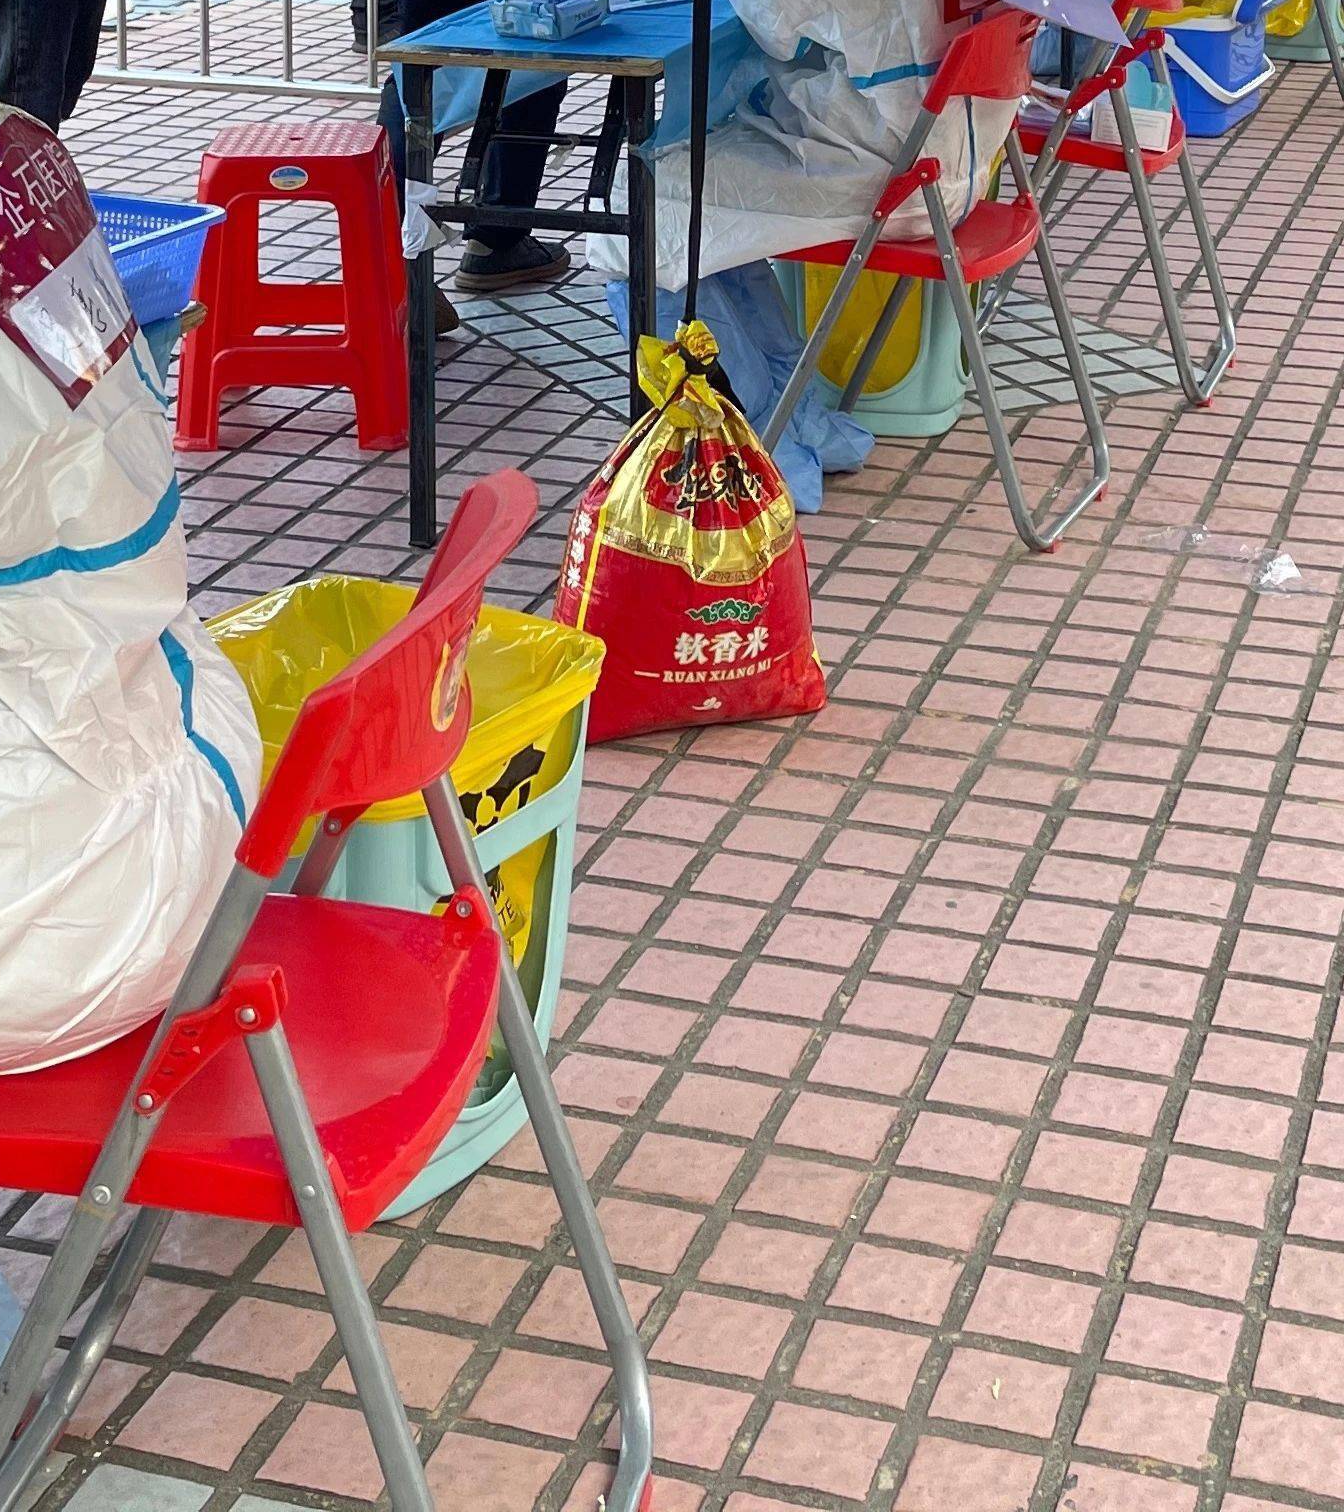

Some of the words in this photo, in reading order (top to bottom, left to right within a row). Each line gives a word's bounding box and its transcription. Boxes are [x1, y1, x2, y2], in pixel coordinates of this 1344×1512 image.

[673, 625, 770, 666] 软香米
[662, 670, 707, 684] RUAN
[708, 664, 756, 682] XIANG
[756, 657, 772, 674] MI
